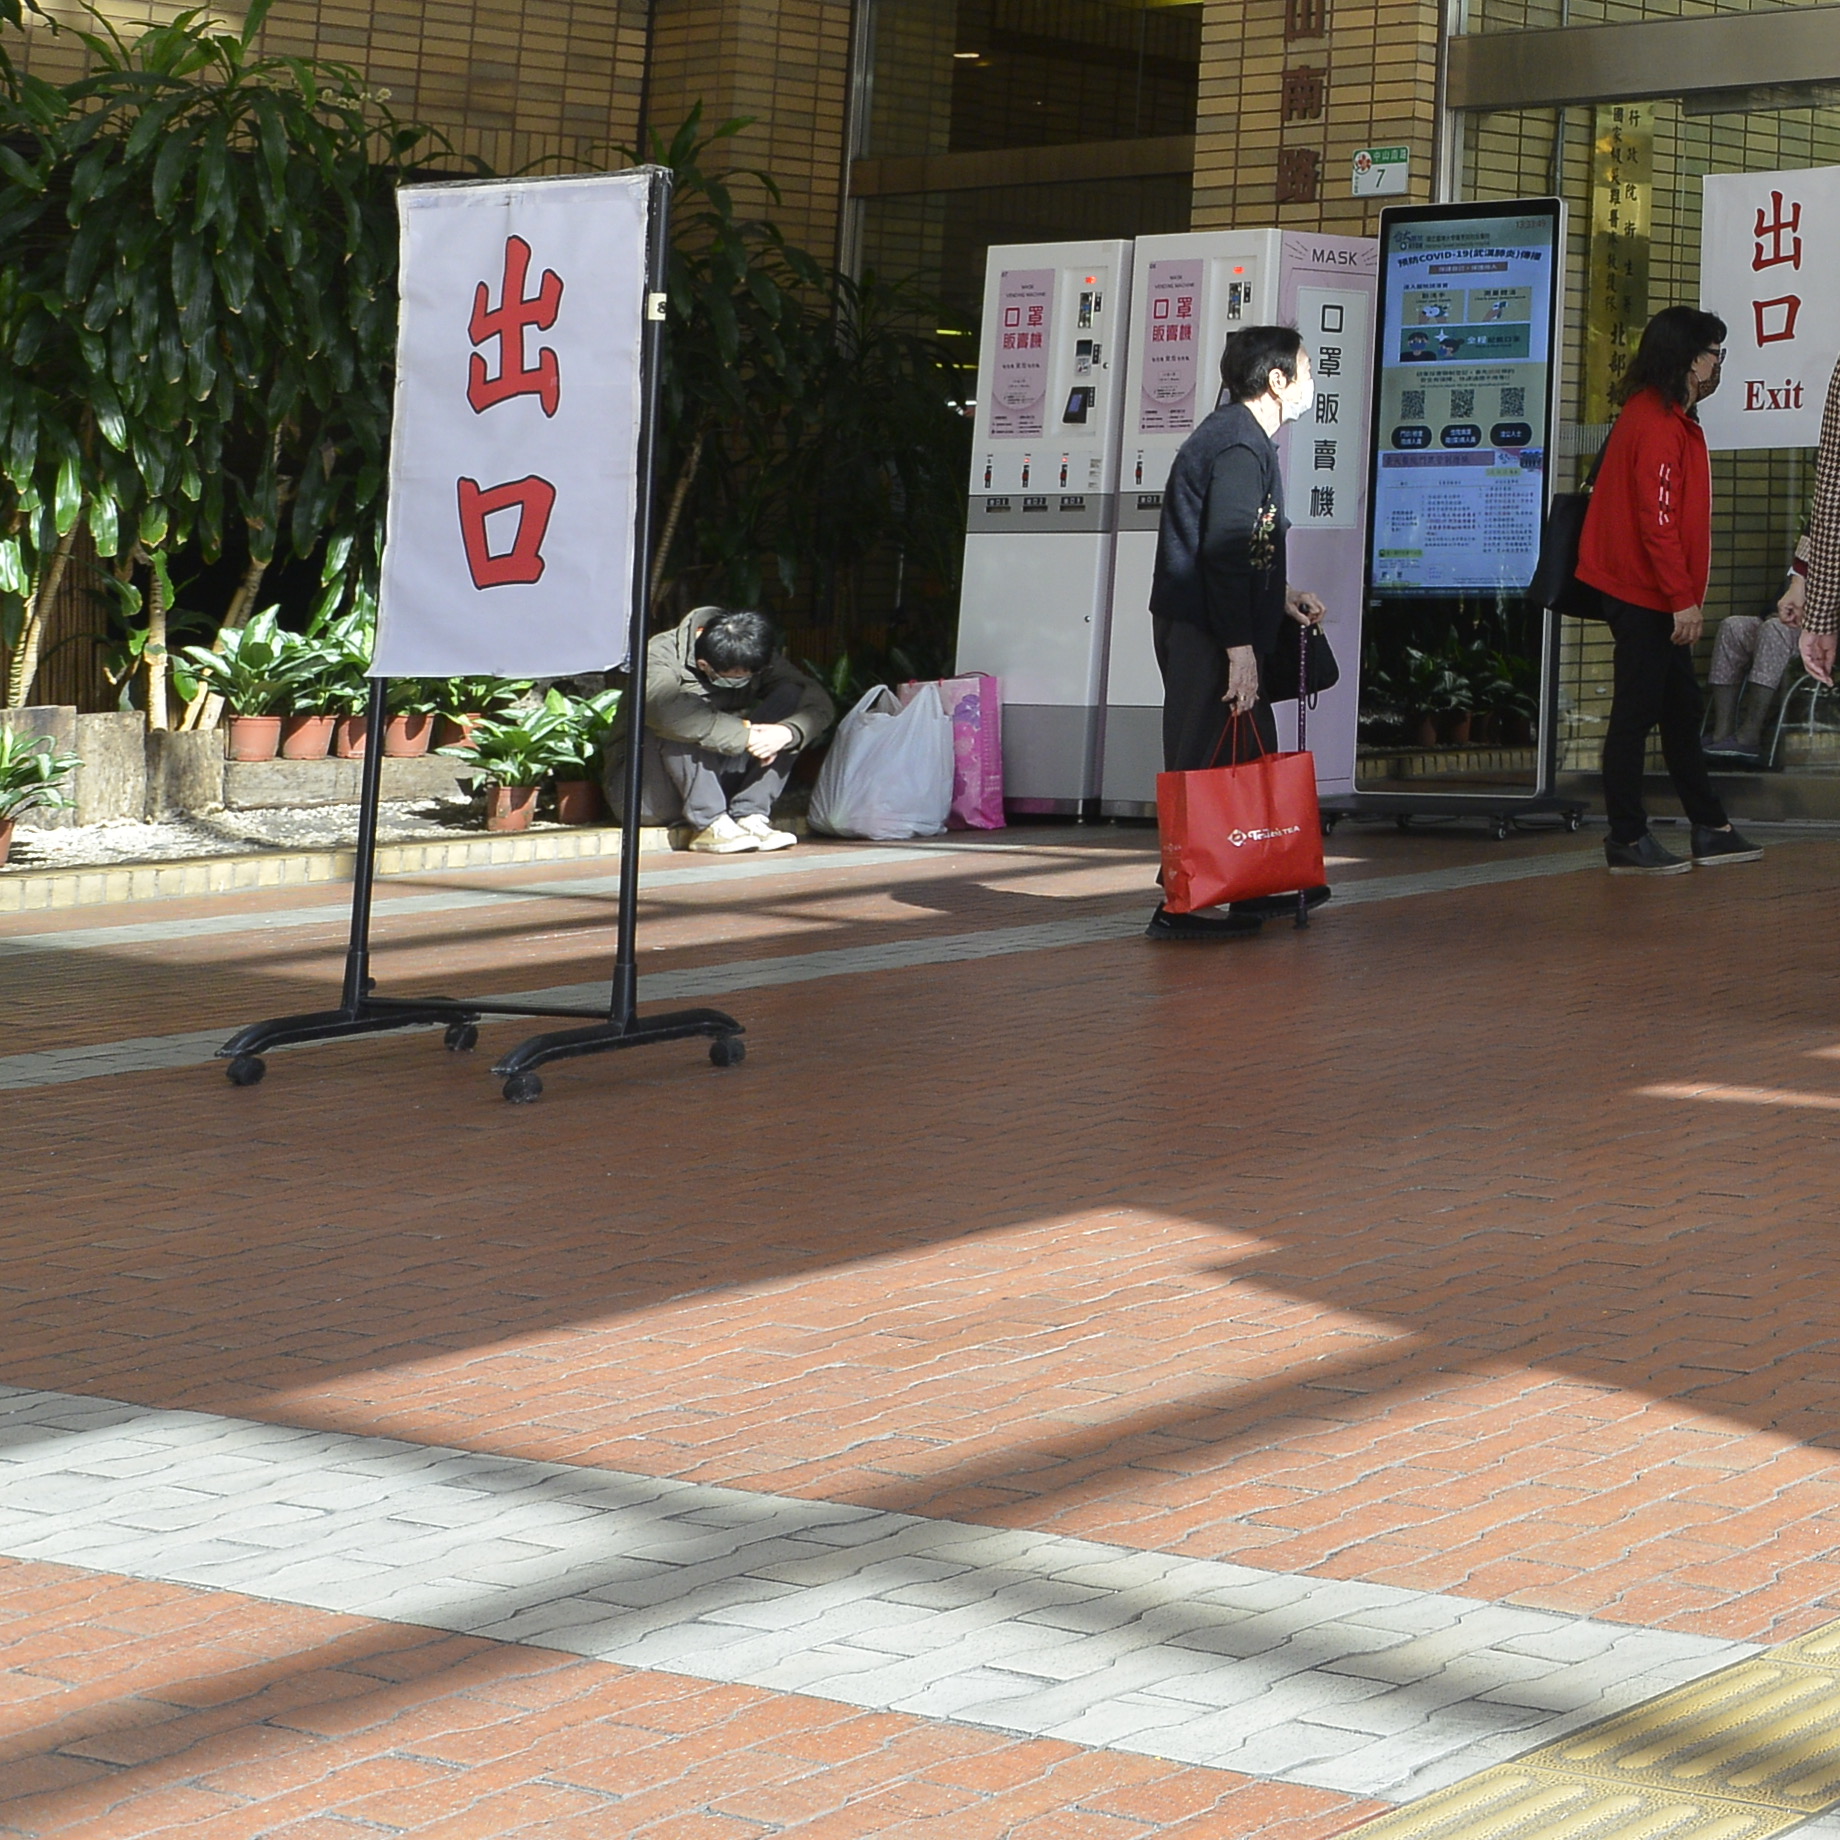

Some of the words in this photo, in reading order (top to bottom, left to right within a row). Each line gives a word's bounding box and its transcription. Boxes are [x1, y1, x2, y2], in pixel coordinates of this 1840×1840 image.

[1375, 168, 1386, 188] 7
[1311, 249, 1359, 267] MASK
[1750, 189, 1804, 350] 出口
[1004, 306, 1044, 328] 口罩
[1153, 296, 1193, 320] 口罩
[1742, 378, 1805, 413] Exit
[457, 233, 565, 591] 出口
[1309, 303, 1346, 520] 口罩販賣機
